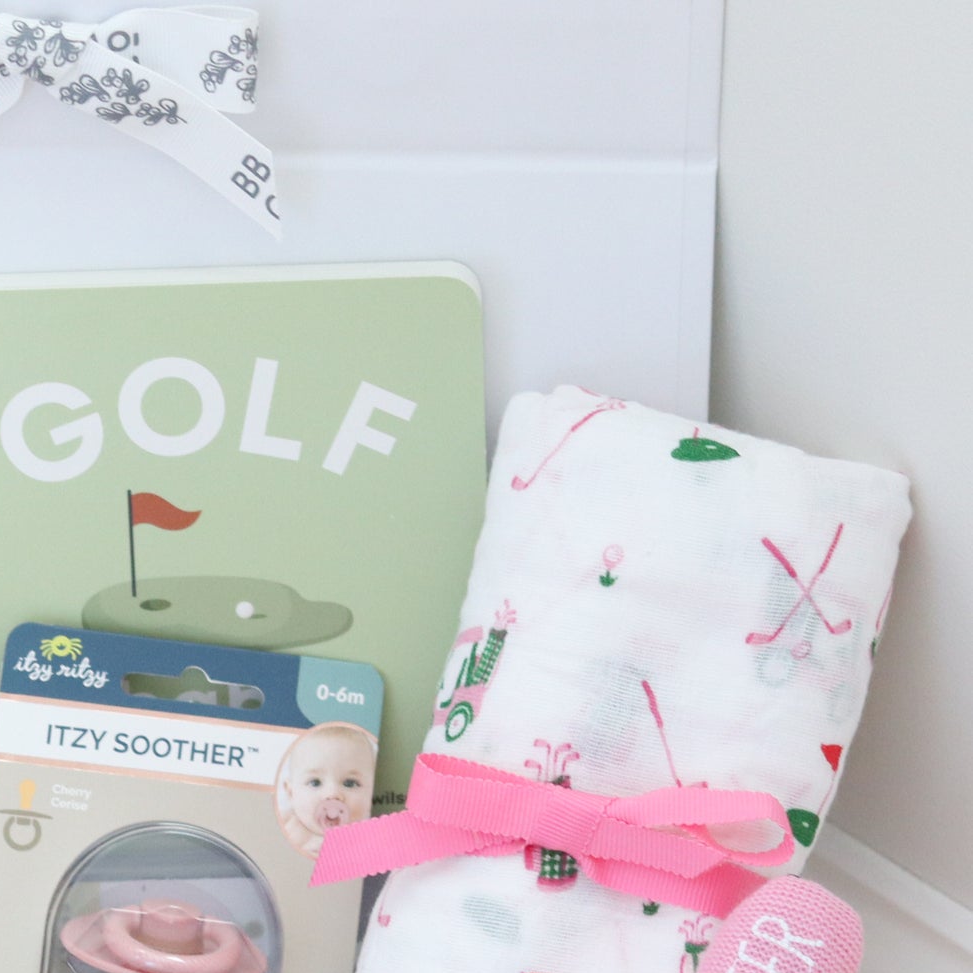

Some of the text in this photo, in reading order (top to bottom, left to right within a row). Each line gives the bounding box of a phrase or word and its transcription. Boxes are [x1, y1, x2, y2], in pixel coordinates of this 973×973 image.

[230, 154, 271, 200] BB
[0, 356, 418, 483] GOLF
[13, 650, 110, 689] itzy ritzy
[316, 684, 365, 705] 0-6m
[46, 724, 107, 750] ITZY
